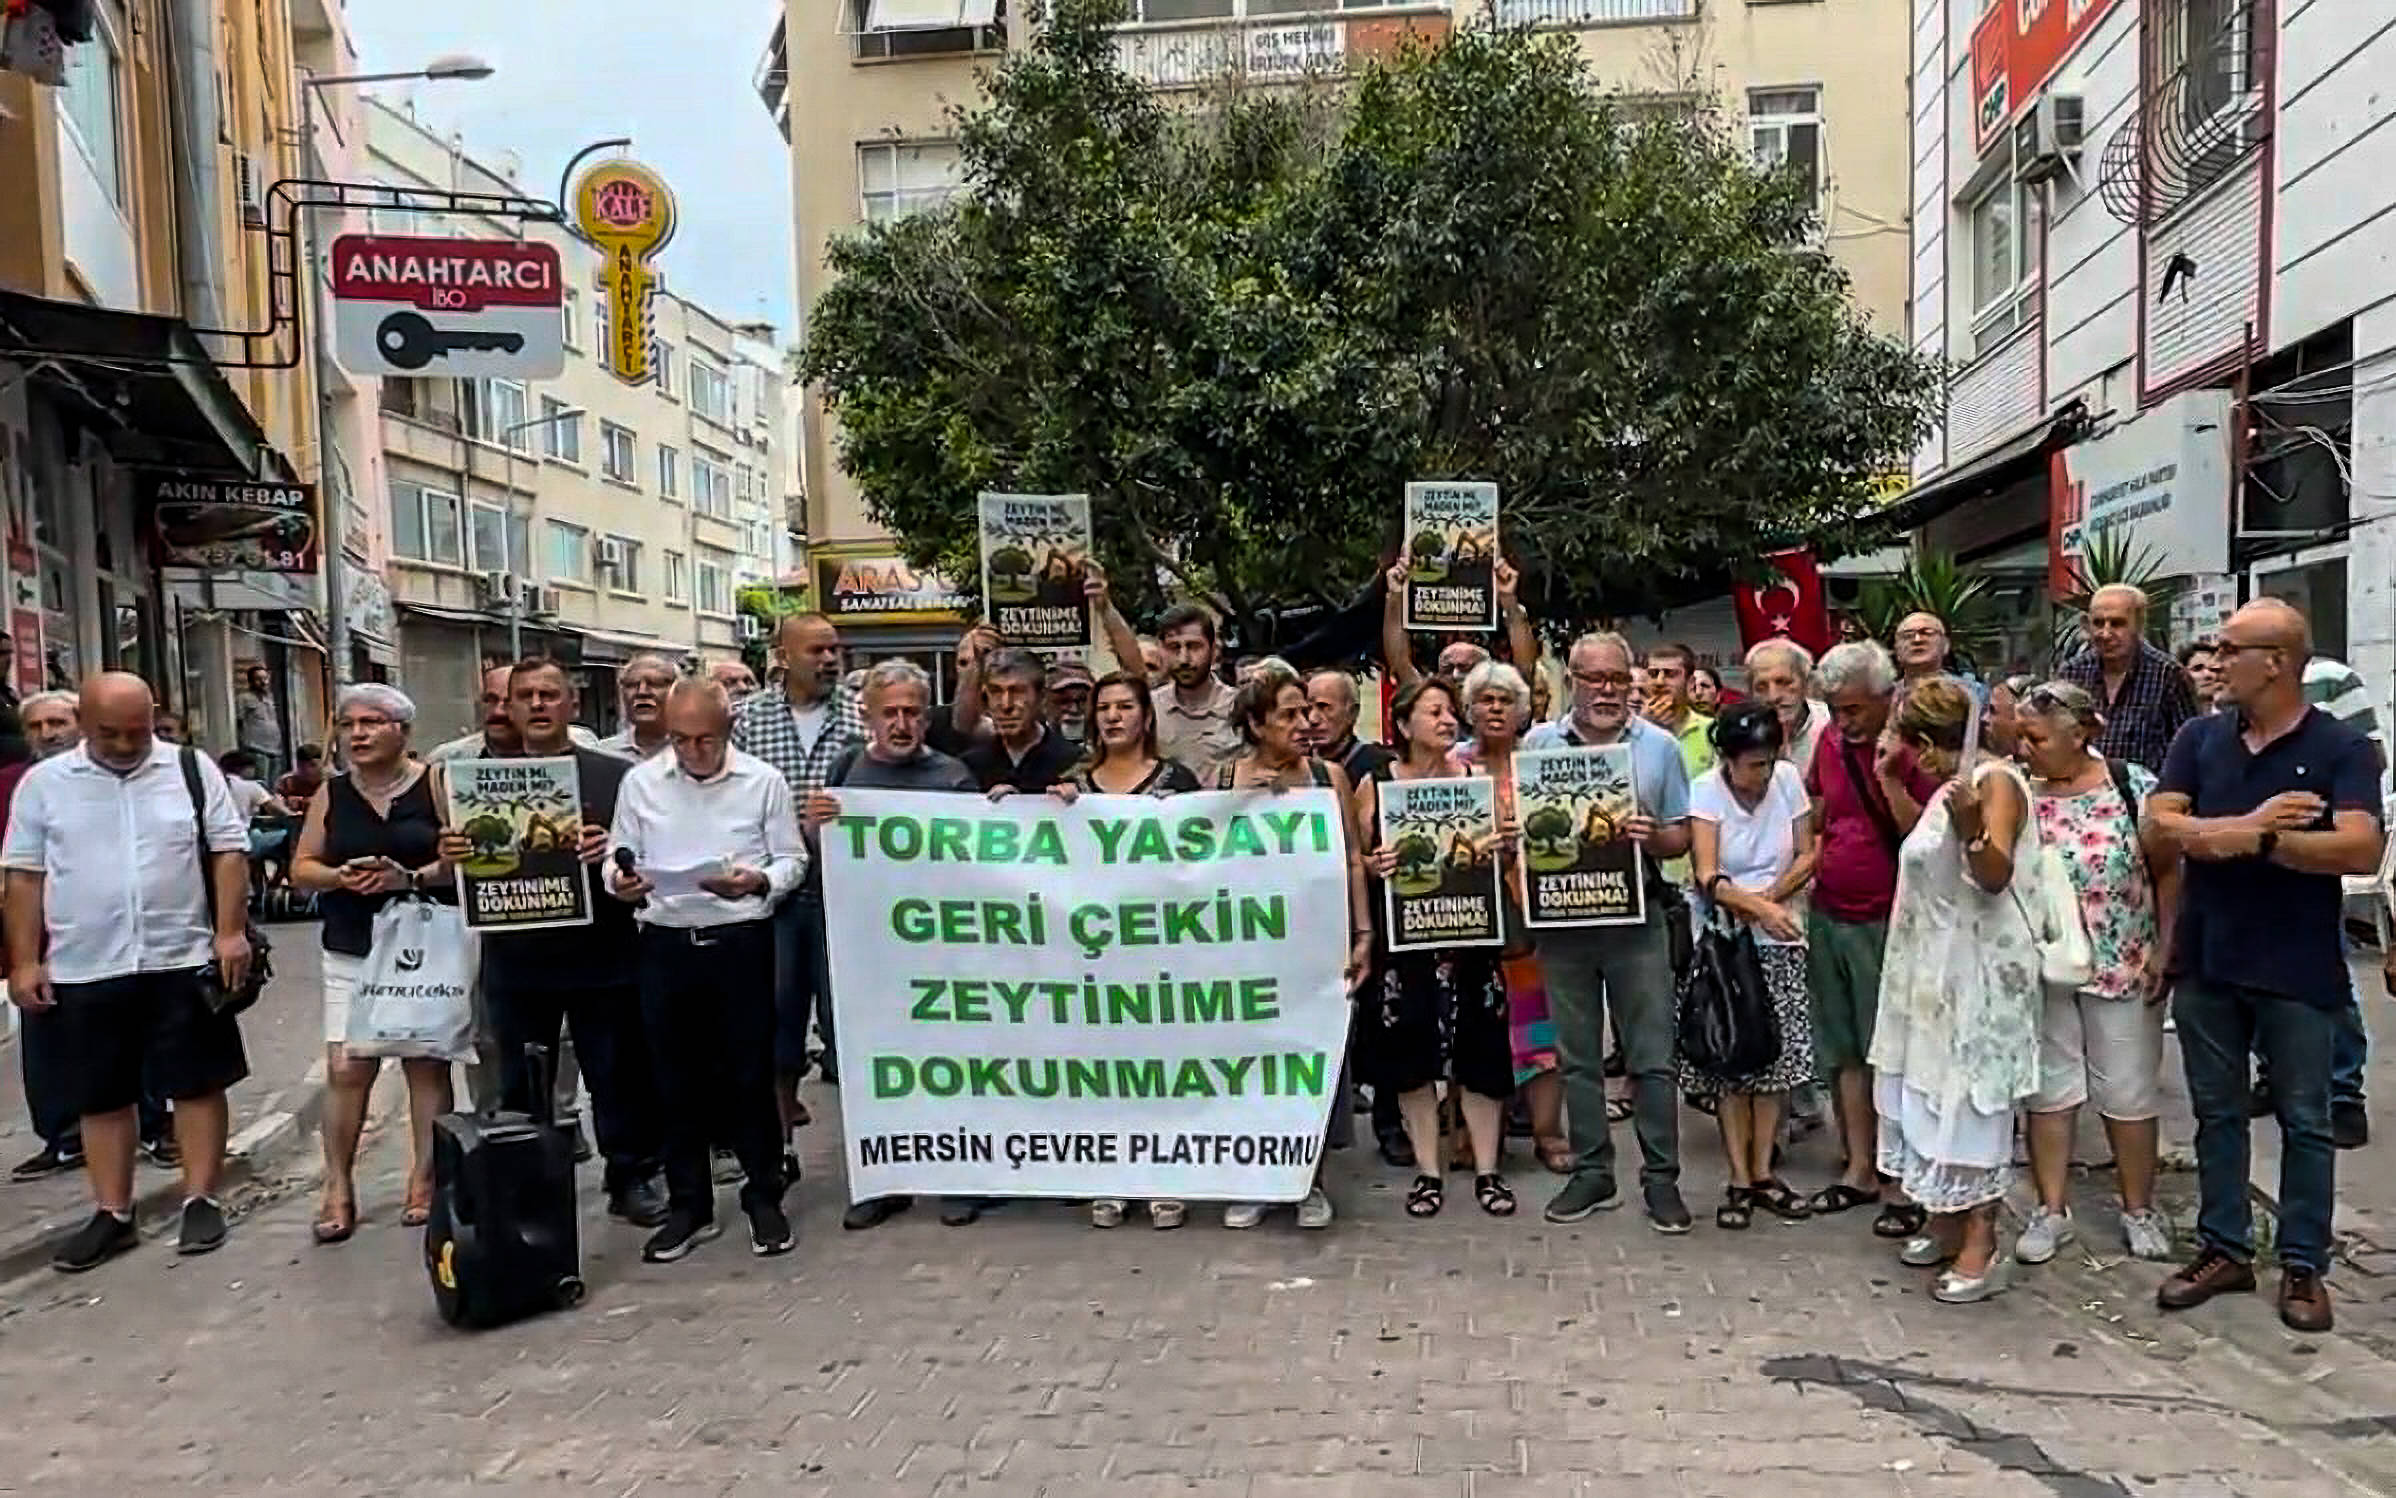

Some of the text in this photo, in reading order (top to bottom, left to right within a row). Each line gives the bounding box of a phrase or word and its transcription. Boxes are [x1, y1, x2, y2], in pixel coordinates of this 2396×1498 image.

[346, 253, 550, 289] ANAHTARCI
[157, 481, 304, 506] AKIN KEBAP
[833, 564, 923, 596] ARAS
[476, 781, 526, 794] MADEN
[838, 812, 1329, 864] TORBA YASAYI
[478, 892, 575, 913] DOKUNMA!
[1538, 887, 1629, 908] DOKUNMA!
[892, 889, 1286, 959] GERİ ÇEKİN
[910, 972, 1280, 1025] ZEYTİNİME
[872, 1052, 1327, 1099] DOKUNMAYIN
[860, 1126, 1319, 1170] MERSİN ÇEVRE PLATFORMU
